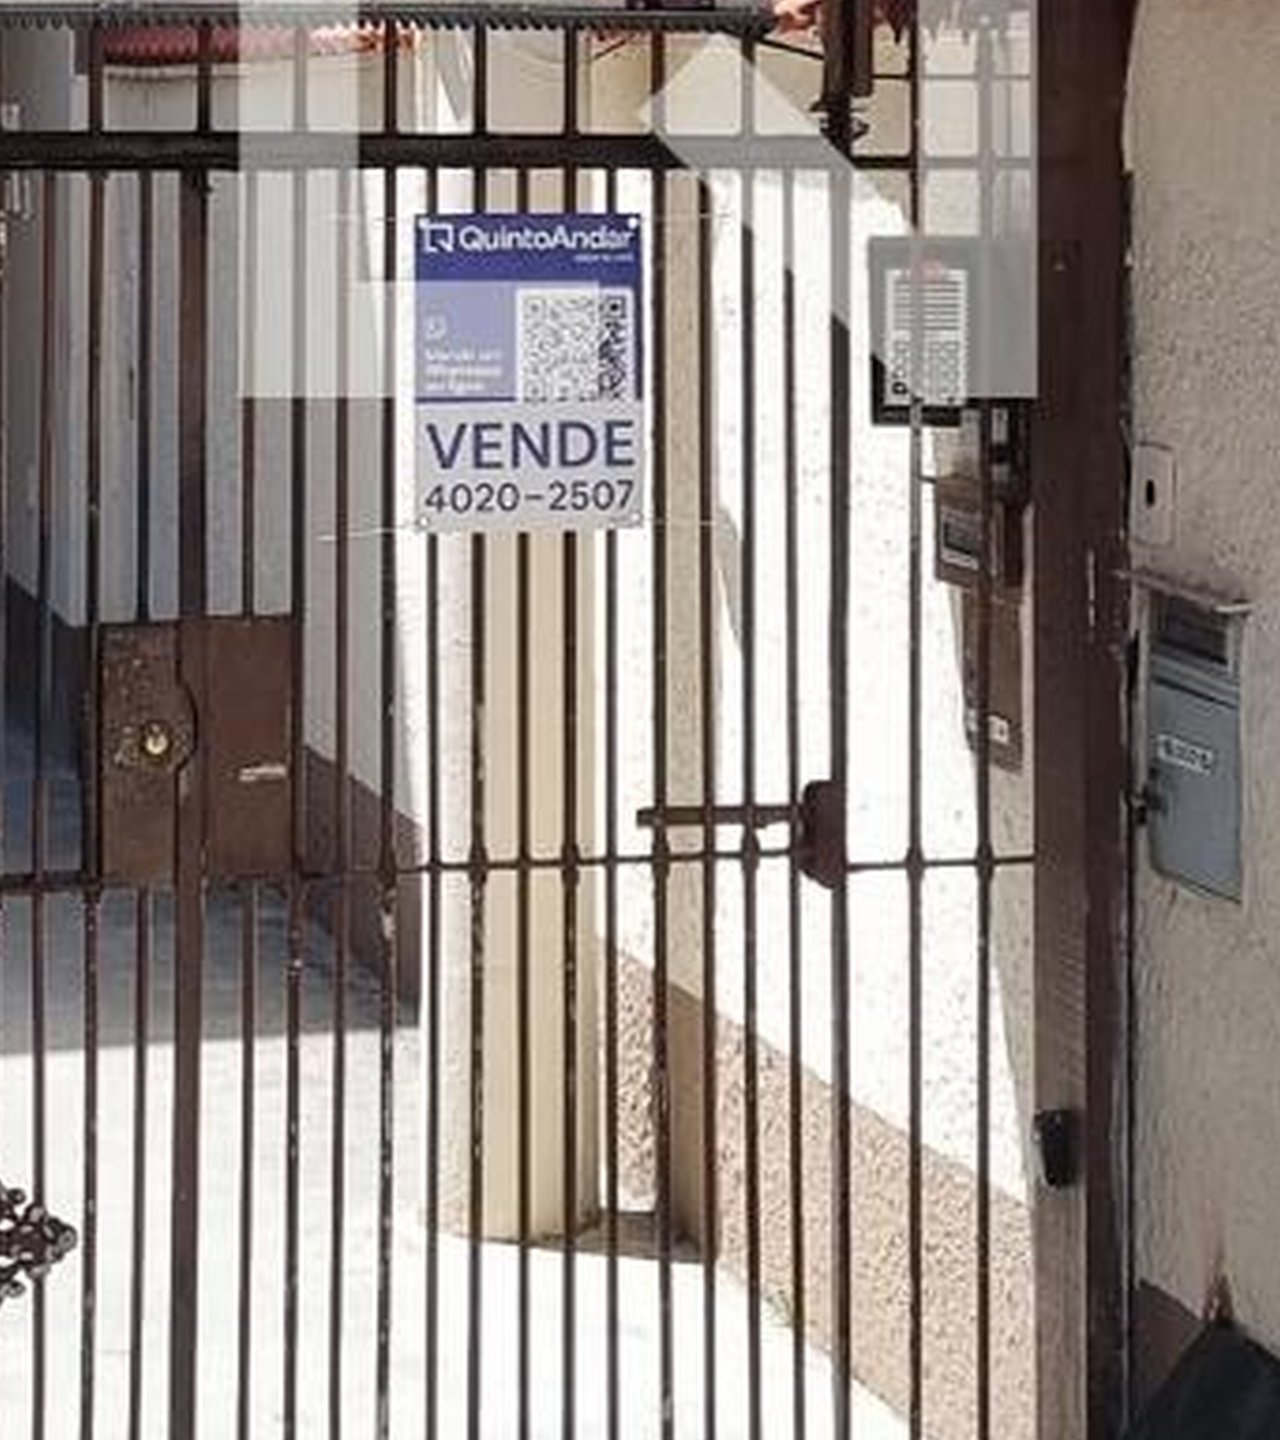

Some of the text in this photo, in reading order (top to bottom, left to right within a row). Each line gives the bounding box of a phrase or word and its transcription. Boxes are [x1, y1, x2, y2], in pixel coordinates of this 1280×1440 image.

[458, 225, 635, 251] QuintoAndar
[425, 420, 635, 470] VENDE
[424, 479, 635, 512] 4020-2507
